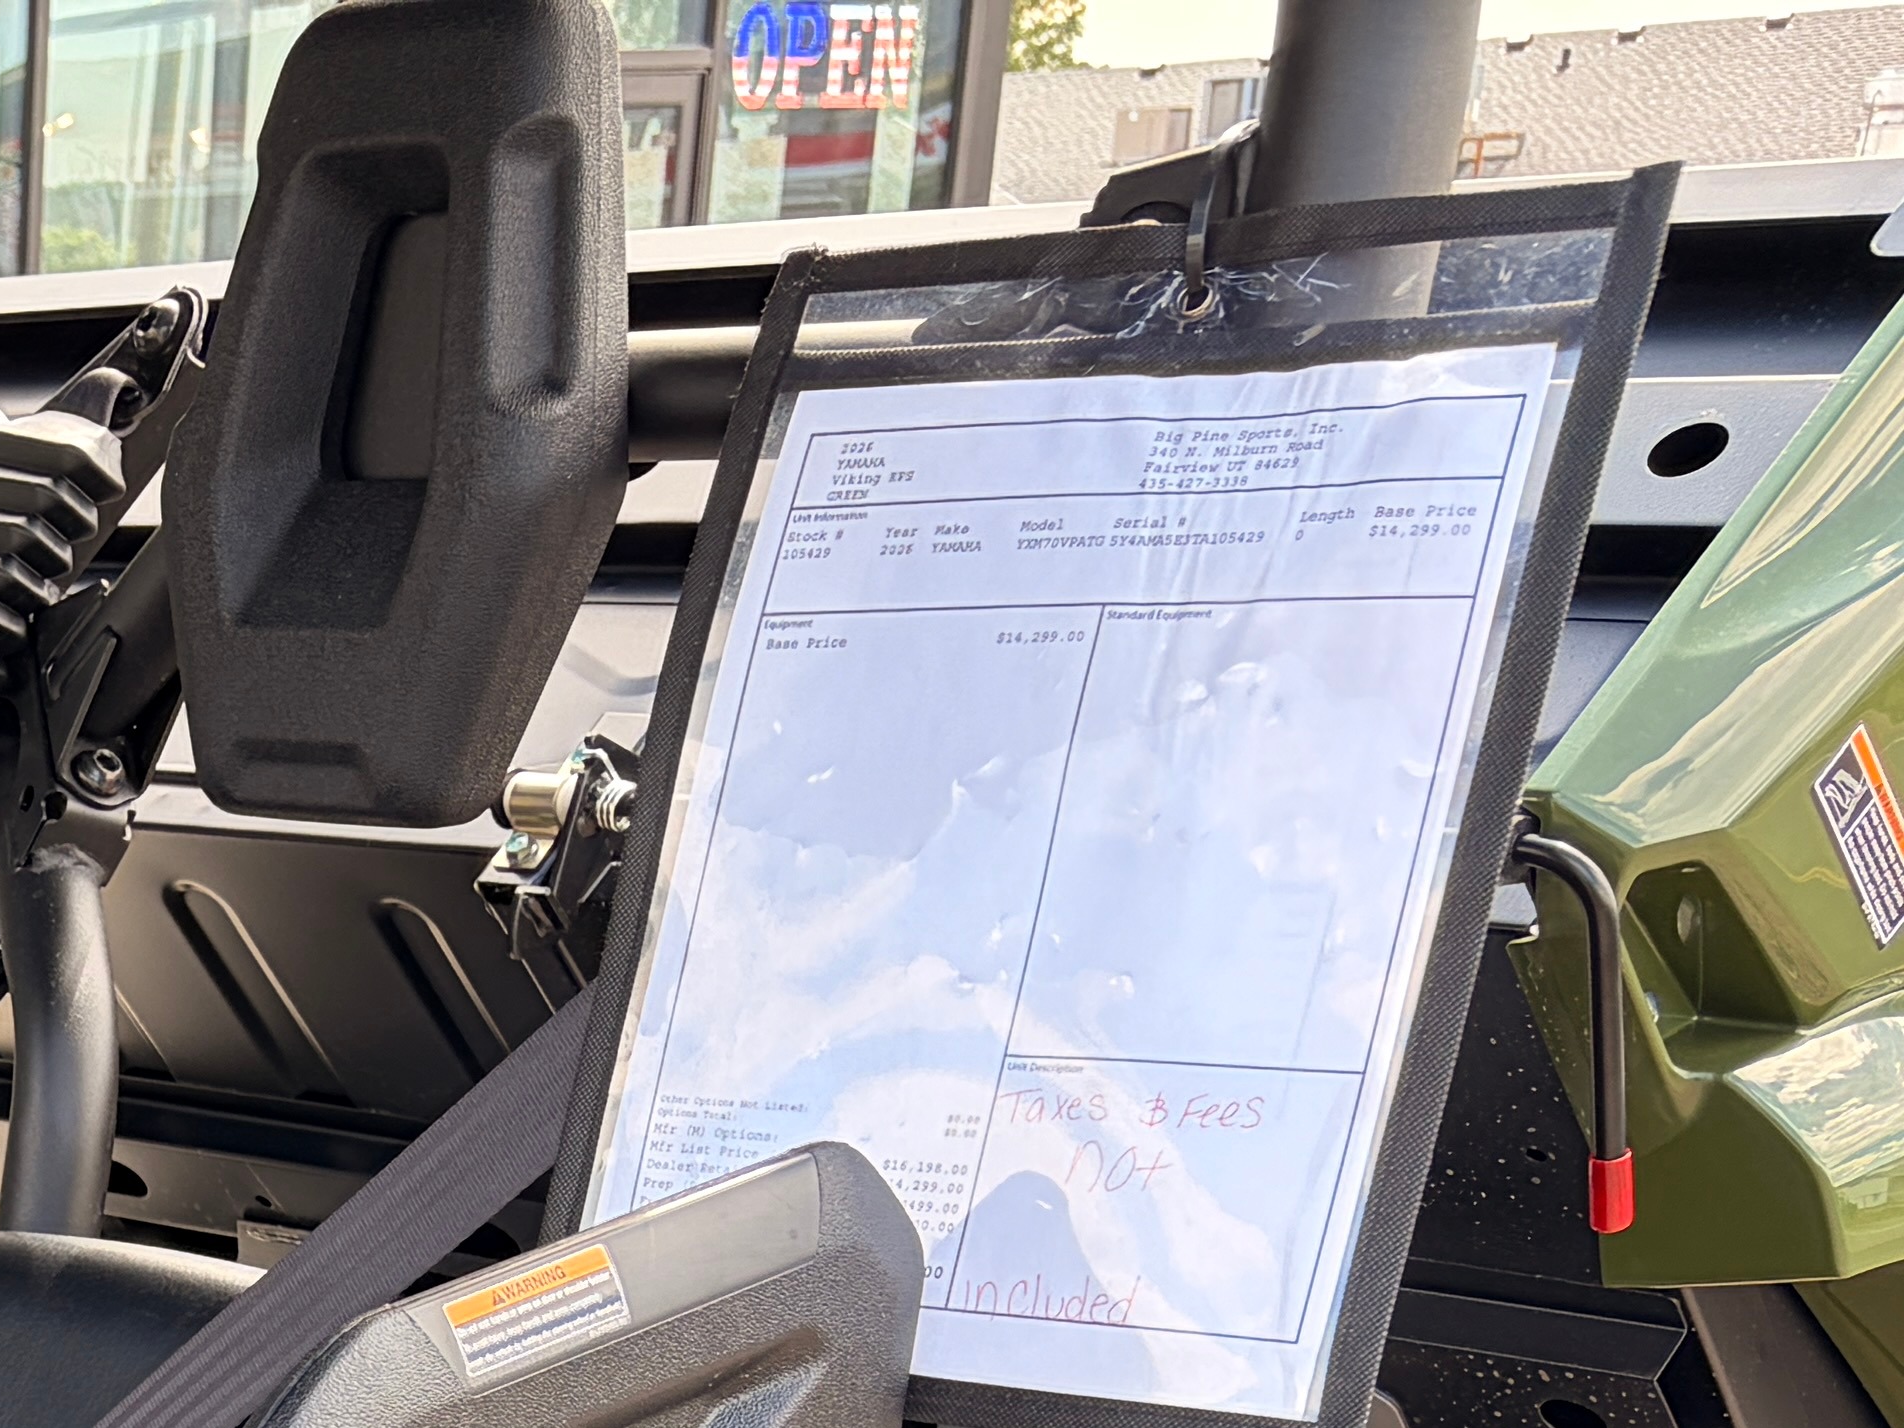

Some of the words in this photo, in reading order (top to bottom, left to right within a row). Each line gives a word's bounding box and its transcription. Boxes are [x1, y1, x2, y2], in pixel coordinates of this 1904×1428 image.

[731, 2, 922, 110] OPEN
[1154, 431, 1184, 445] Big
[1191, 430, 1229, 442] Pine
[1309, 422, 1344, 435] Inc.
[1148, 446, 1178, 458] 340
[1212, 443, 1278, 457] Milburn
[1288, 439, 1324, 452] Road
[1143, 460, 1220, 474] Fairview
[1226, 460, 1247, 472] UT
[1254, 457, 1300, 471] 84629
[832, 474, 881, 487] Viking
[826, 489, 869, 501] GREEN
[1299, 508, 1356, 525] Length
[1374, 505, 1415, 518] Base
[1426, 504, 1477, 518] Price
[935, 524, 969, 536] Make
[1020, 518, 1065, 532] Model
[1114, 516, 1168, 529] Serial
[1177, 516, 1186, 527] #
[787, 530, 827, 542] Stock
[885, 527, 919, 539] Year
[1368, 523, 1472, 539] $14,299.00
[931, 540, 982, 553] YAMAHA
[1107, 608, 1154, 620] Standard
[1156, 609, 1212, 622] Equipment
[766, 638, 799, 650] Base
[806, 636, 847, 649] Price
[996, 630, 1086, 645] $14,299.00
[999, 1087, 1110, 1124] Taxes
[1176, 1092, 1266, 1129] Fees
[653, 1123, 678, 1135] Mfr
[714, 1127, 780, 1144] Options:
[649, 1140, 674, 1153] Mfr
[681, 1142, 711, 1156] List
[719, 1145, 760, 1160] Price
[646, 1158, 694, 1173] Dealer
[643, 1176, 674, 1191] Prep
[890, 1178, 964, 1195] 4,299.00
[904, 1199, 960, 1215] 499.00
[915, 1219, 955, 1234] 0.00
[504, 1264, 567, 1300] WARNING
